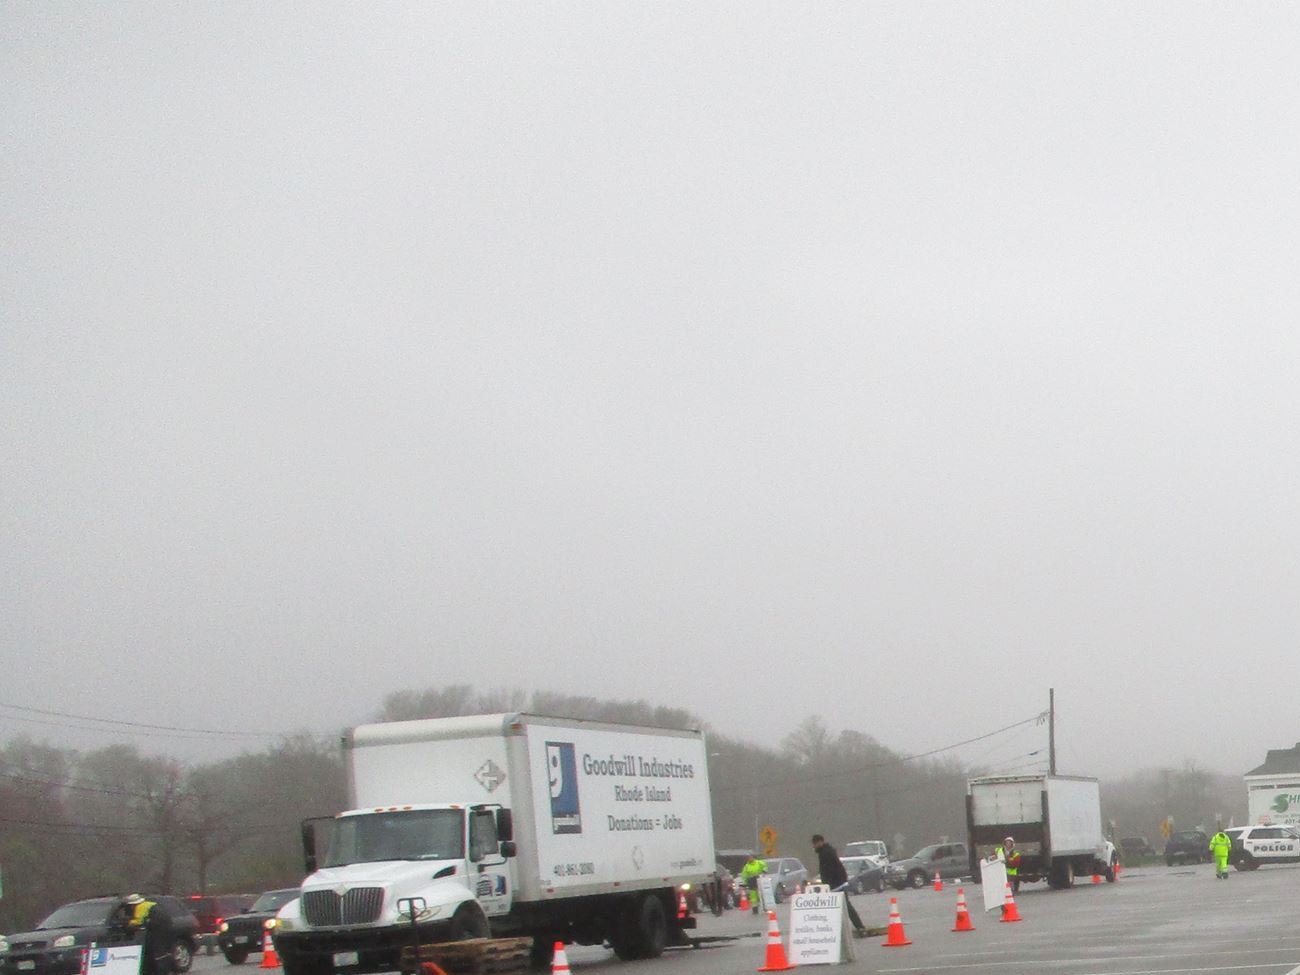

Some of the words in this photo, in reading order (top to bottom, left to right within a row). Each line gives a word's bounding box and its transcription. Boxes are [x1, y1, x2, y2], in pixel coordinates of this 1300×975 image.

[583, 753, 637, 777] Goodwill
[639, 756, 695, 779] Industries
[614, 784, 644, 802] Rhode
[645, 785, 672, 802] Island
[607, 814, 654, 831] Donations
[663, 814, 683, 830] Jobs
[1253, 844, 1294, 852] POLICE
[795, 895, 838, 908] Goodwill
